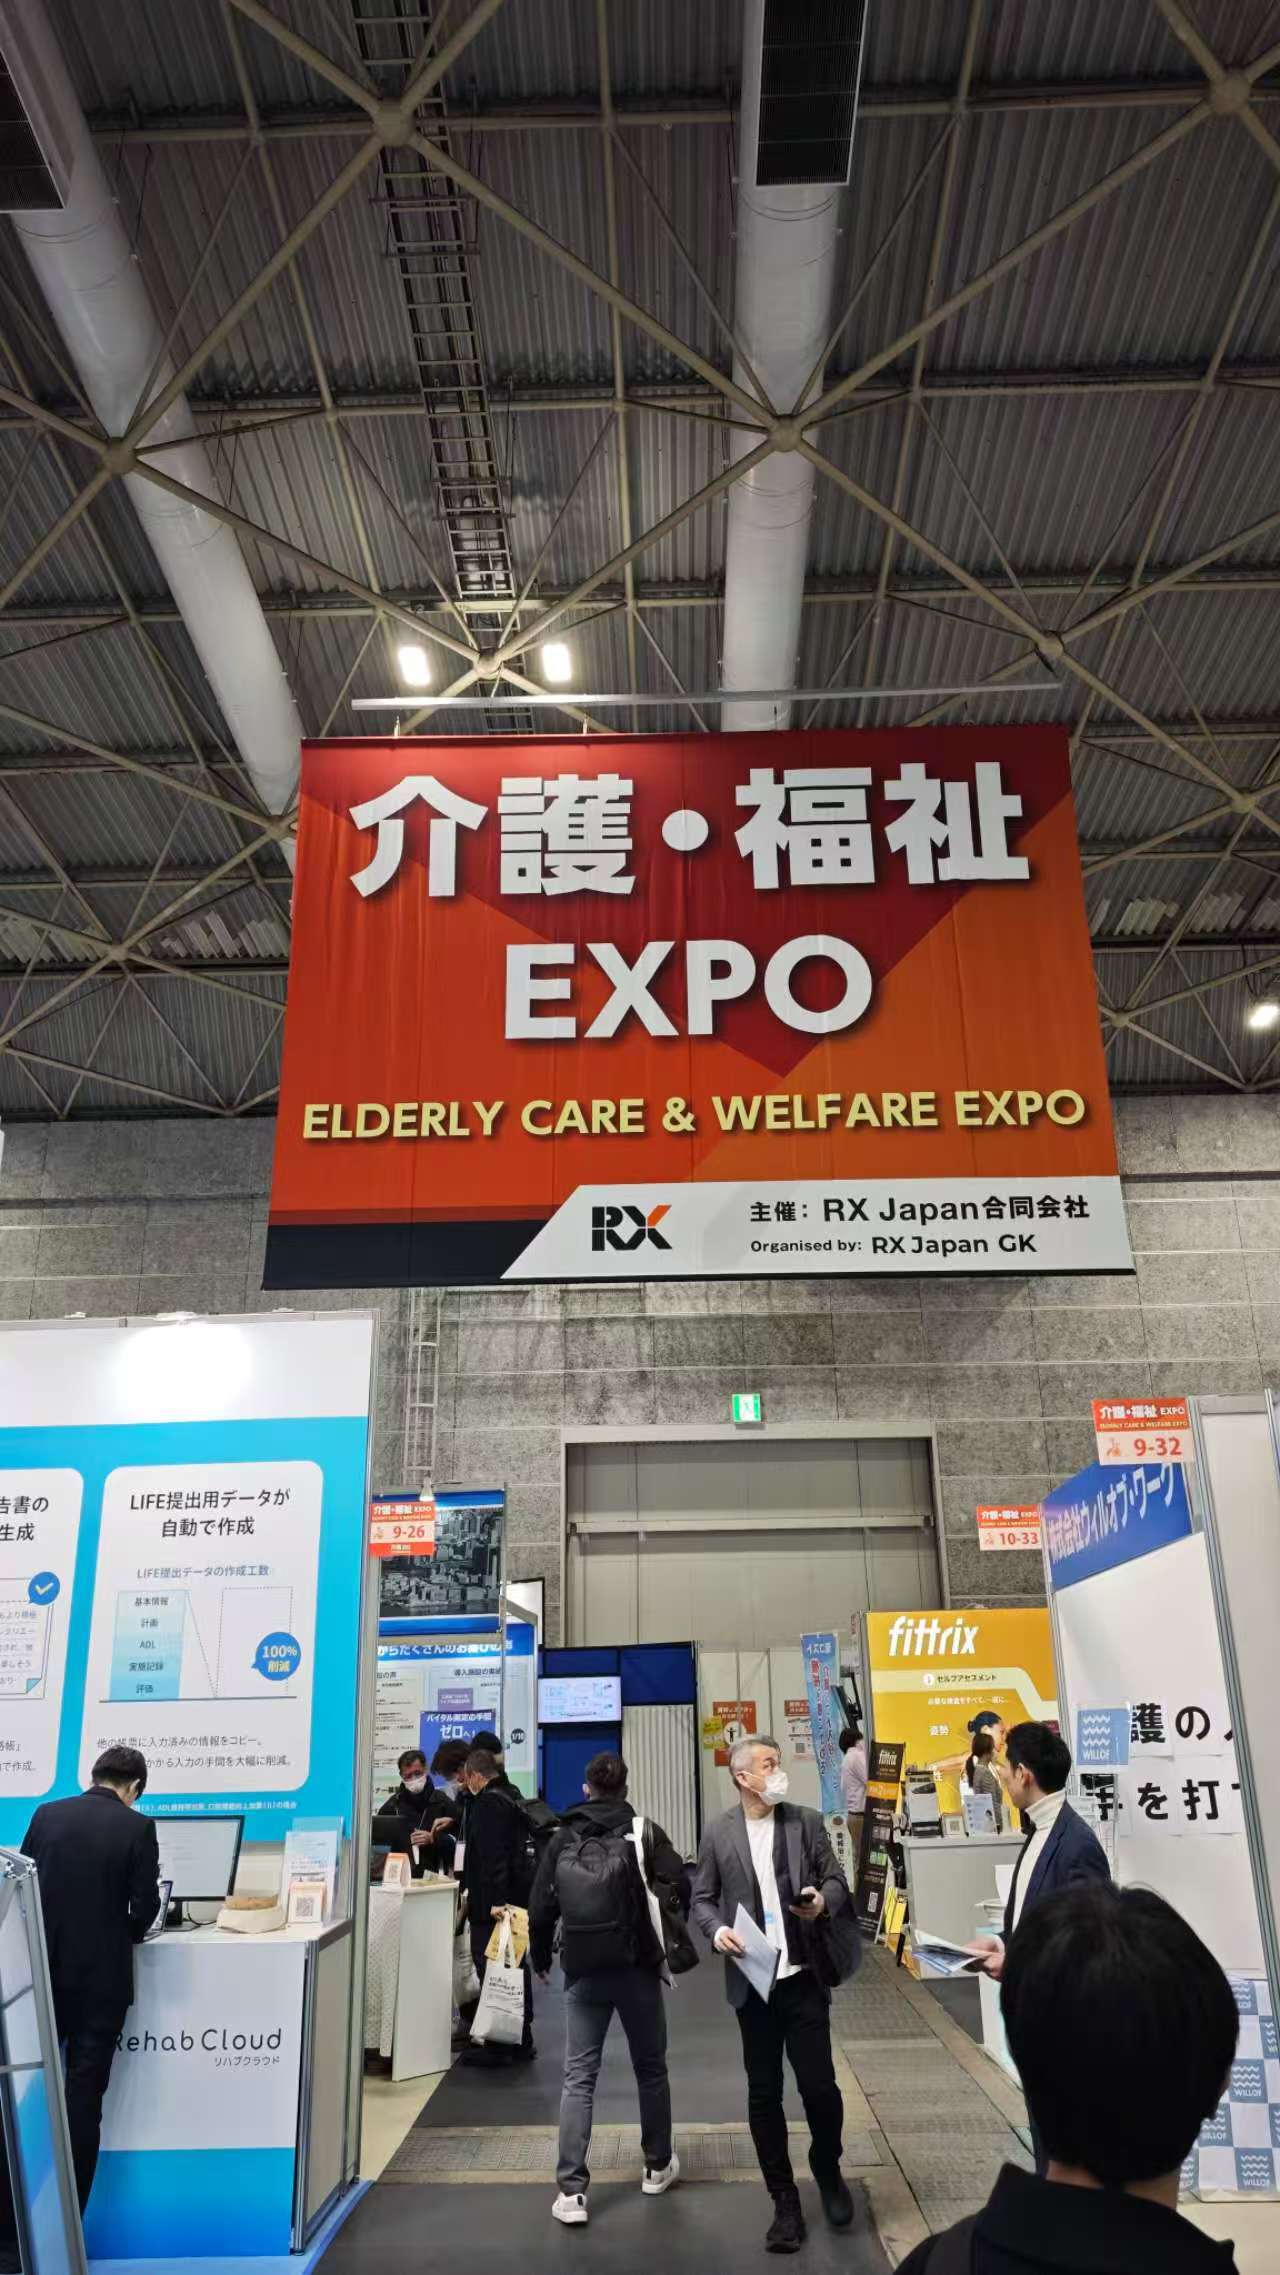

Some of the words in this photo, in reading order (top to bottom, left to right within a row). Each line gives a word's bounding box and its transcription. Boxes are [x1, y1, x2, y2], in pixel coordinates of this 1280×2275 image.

[349, 761, 1030, 897] 介護・福祉
[505, 934, 873, 1040] EXPO
[303, 1101, 504, 1138] ELDERLY
[521, 1099, 644, 1135] CARE
[662, 1096, 696, 1132] &
[712, 1092, 939, 1131] WELFARE
[954, 1089, 1086, 1127] EXPO
[823, 1198, 870, 1222] RX
[592, 1204, 673, 1251] RX
[750, 1239, 833, 1254] Organised
[837, 1239, 863, 1255] by:
[872, 1237, 906, 1254] RX
[911, 1236, 988, 1256] Japan
[998, 1234, 1037, 1253] GK
[1099, 1405, 1158, 1419] 介護・福祉
[1160, 1407, 1185, 1415] EXPO
[1134, 1437, 1182, 1456] 9-32
[130, 1488, 291, 1511] LIFE提出用データが
[161, 1517, 255, 1538] 自動で作成
[393, 1526, 425, 1539] 9-26
[1000, 1532, 1039, 1545] 10-33
[137, 1565, 269, 1579] LIFE提出データの作成工数
[140, 1640, 156, 1649] ADL
[888, 1616, 979, 1657] fittrix
[262, 1645, 298, 1659] 100%
[937, 1674, 996, 1683] セルフアセスメント
[1130, 1703, 1233, 1743] 護の
[215, 2056, 280, 2067] リハブクラウド
